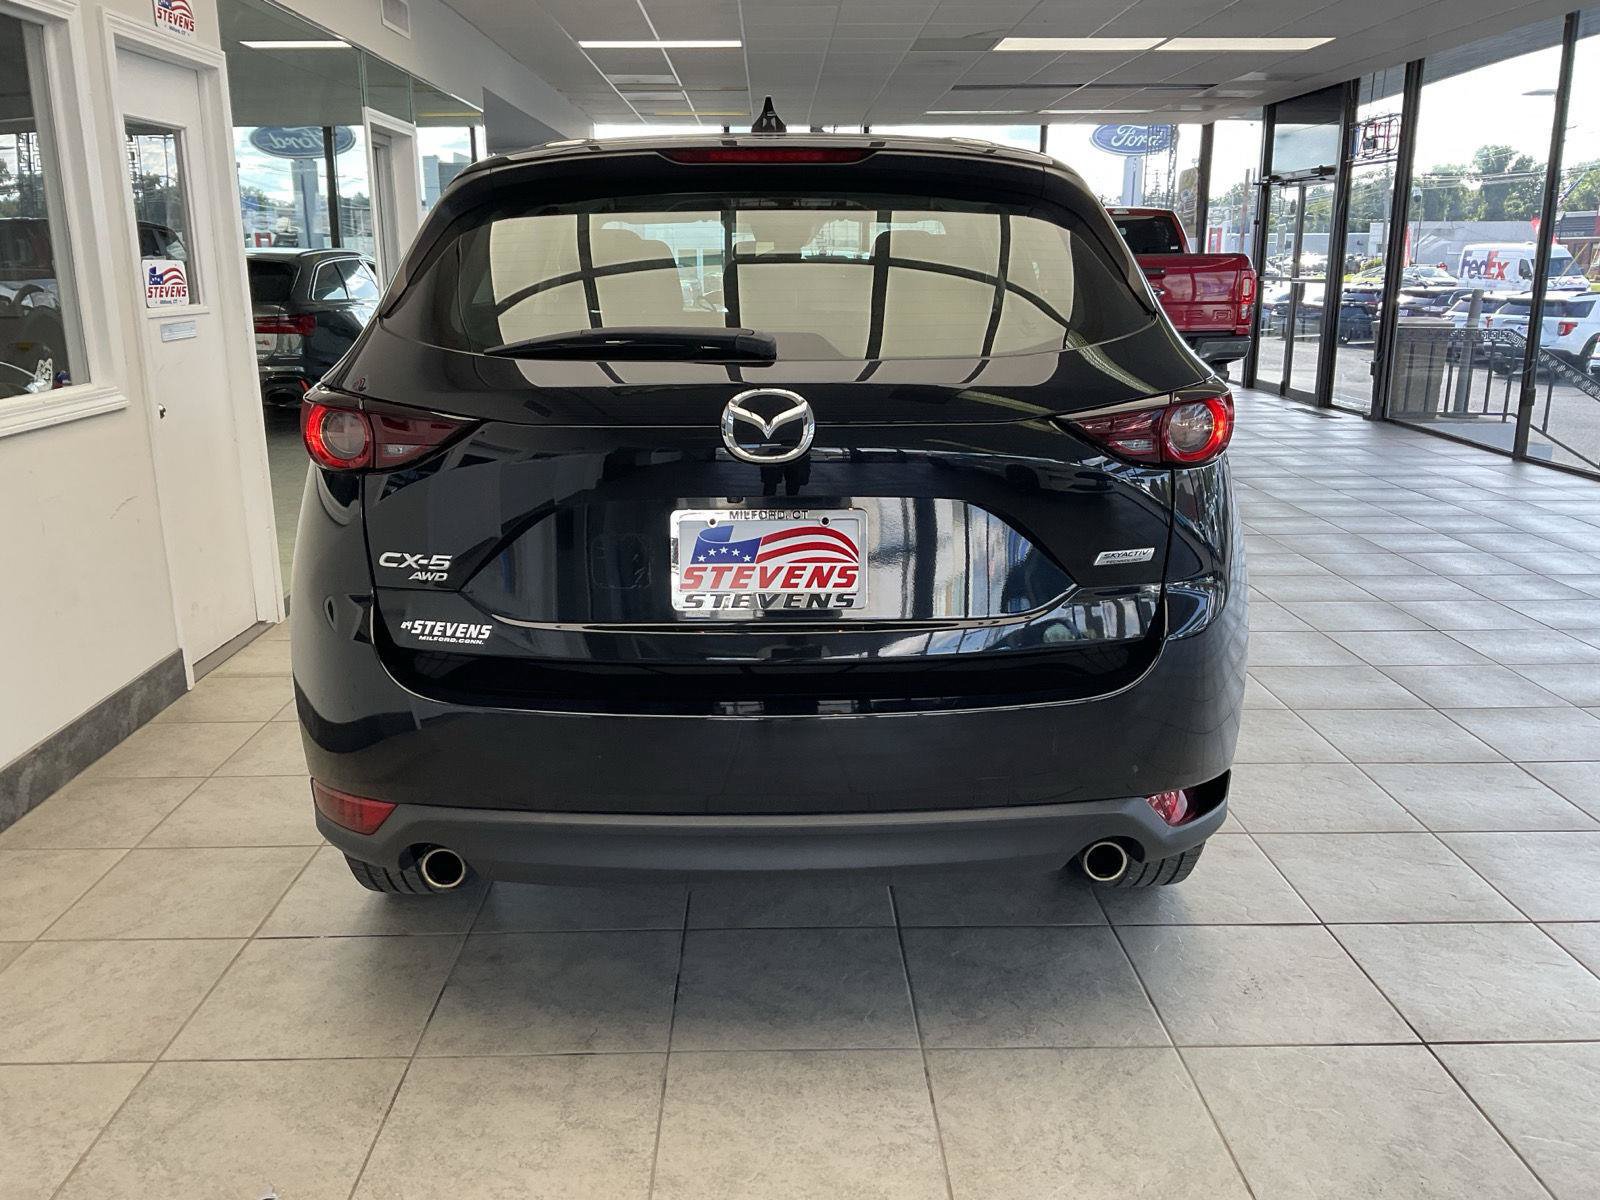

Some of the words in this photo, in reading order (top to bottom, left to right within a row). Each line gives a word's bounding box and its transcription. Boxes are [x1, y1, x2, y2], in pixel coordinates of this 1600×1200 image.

[157, 7, 195, 32] STEVENS
[1460, 249, 1510, 280] FedEx
[147, 286, 187, 299] STEVENS
[792, 510, 809, 520] CT
[378, 551, 453, 570] CX-5
[1103, 549, 1150, 559] SKYACTIV
[408, 571, 449, 581] AWD
[680, 565, 859, 590] STEVENS
[682, 592, 857, 609] STEVENS
[411, 620, 493, 639] STEVENS
